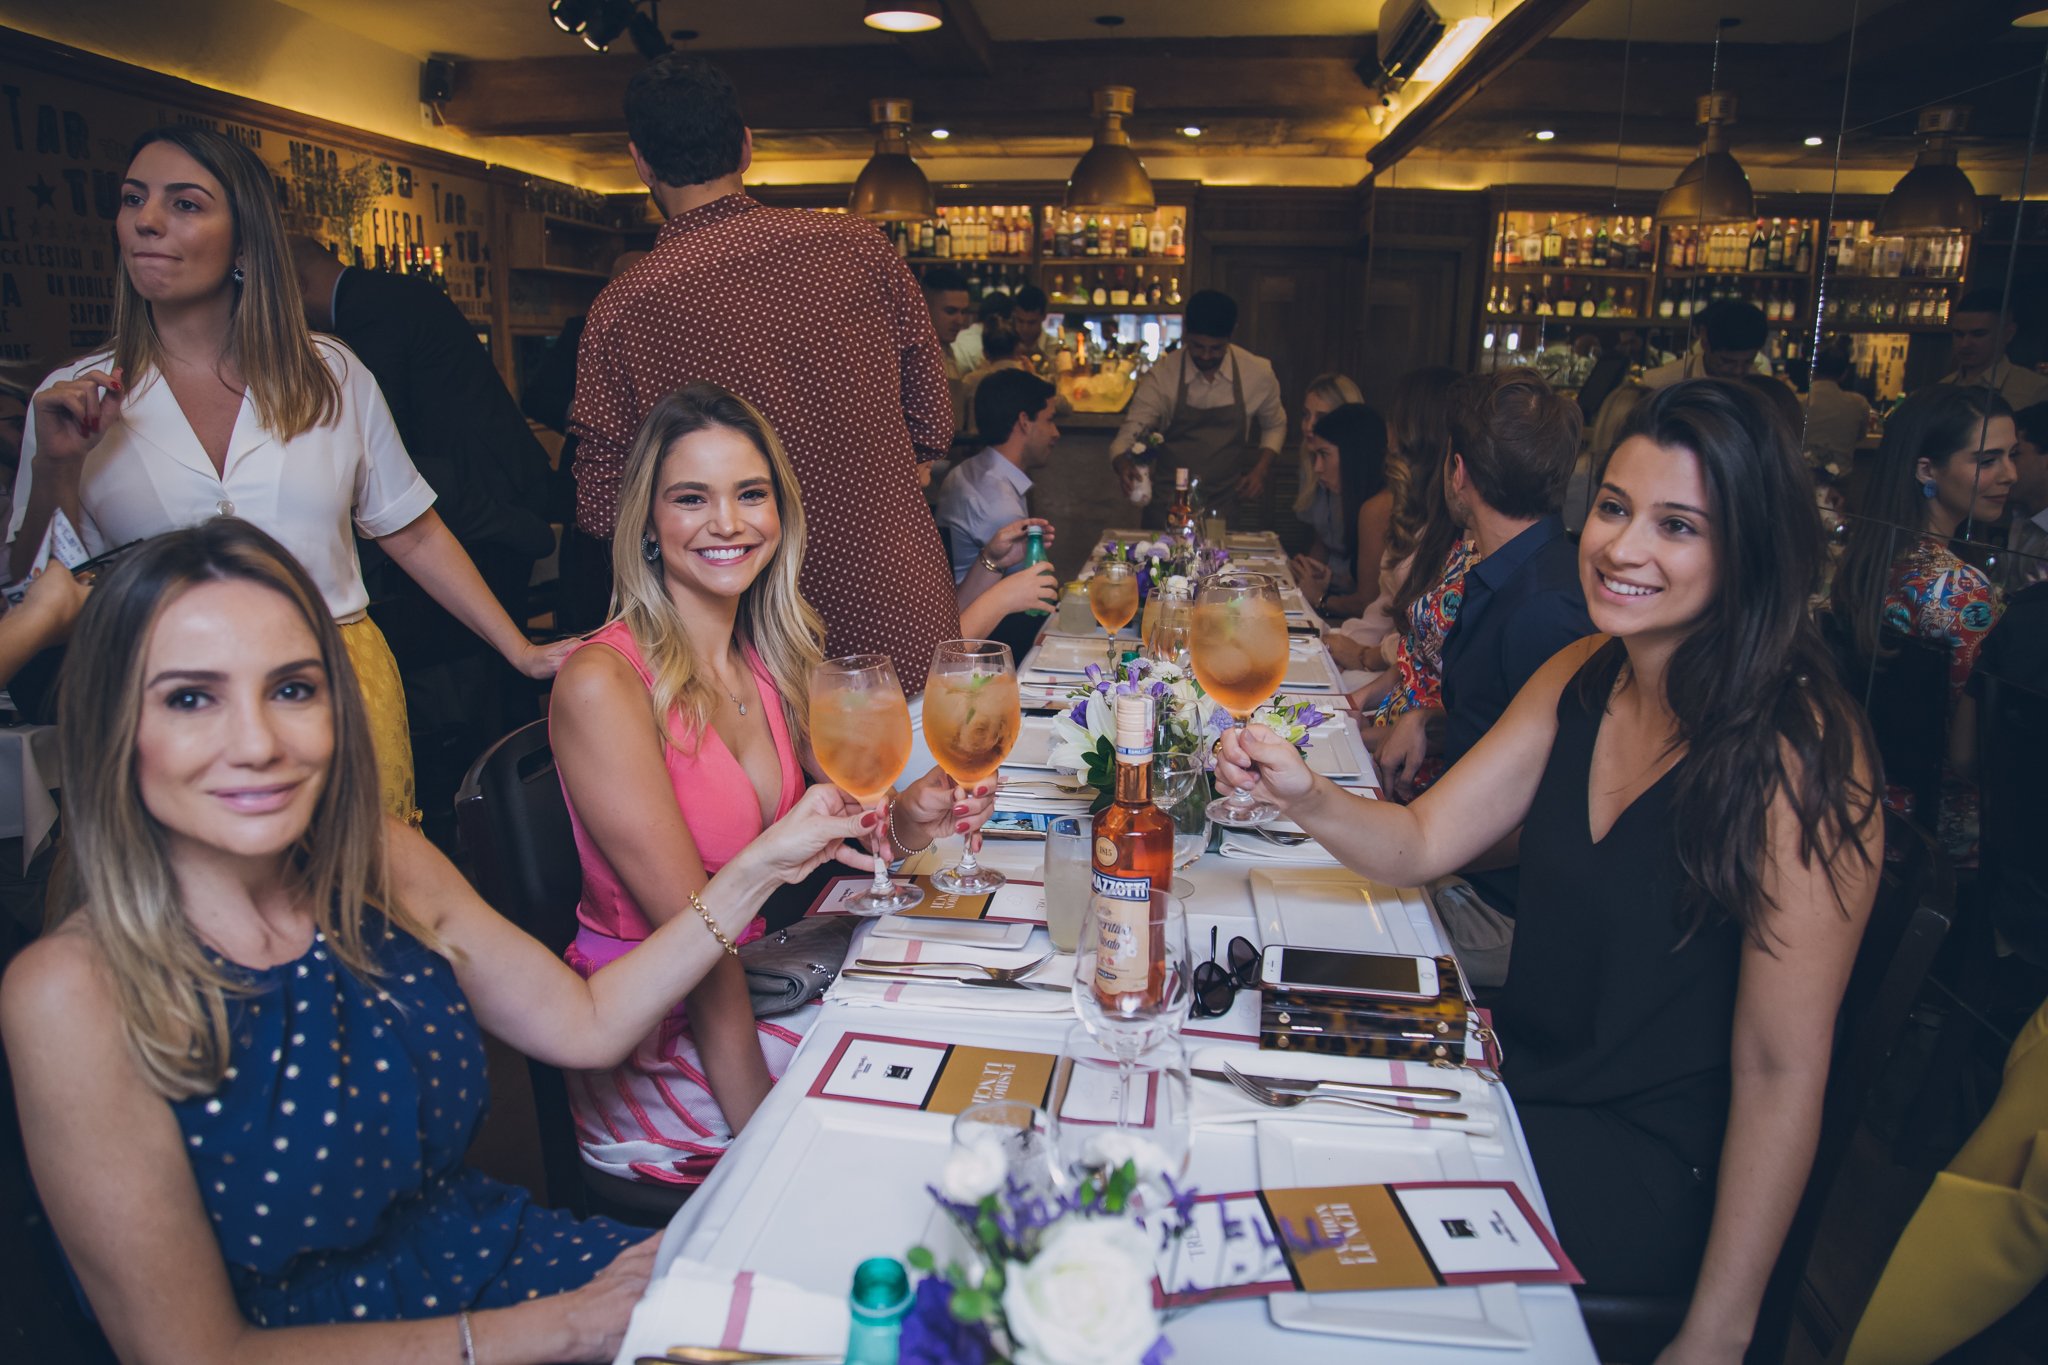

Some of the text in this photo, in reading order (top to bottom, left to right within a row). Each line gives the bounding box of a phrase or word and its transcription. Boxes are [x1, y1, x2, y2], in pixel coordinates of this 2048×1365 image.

[70, 303, 113, 326] SAPOR
[1099, 845, 1113, 857] 1815
[992, 1063, 1016, 1101] FASHIO
